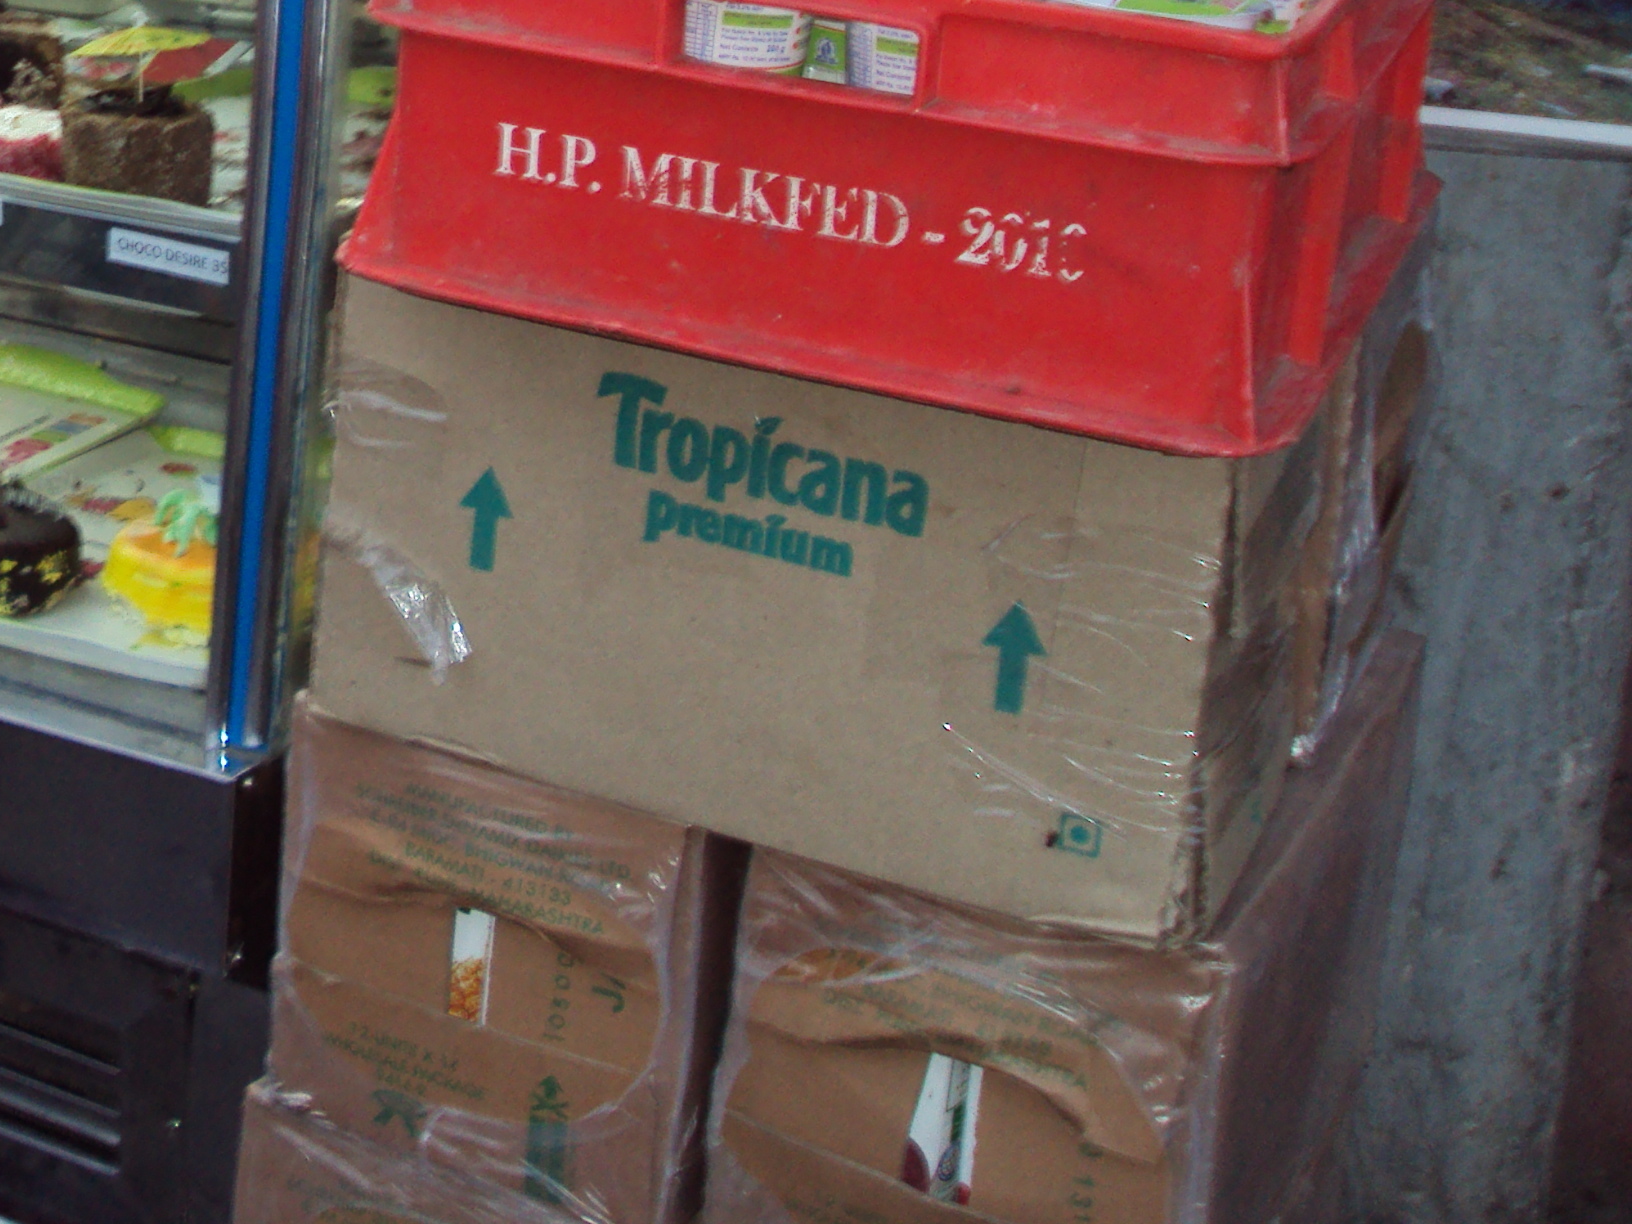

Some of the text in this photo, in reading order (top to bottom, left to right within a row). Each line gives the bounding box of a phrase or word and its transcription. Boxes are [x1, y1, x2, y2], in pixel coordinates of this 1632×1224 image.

[495, 121, 602, 194] H.P.
[619, 144, 911, 249] MILKFED
[117, 237, 228, 274] CHOCO DESIRE 35
[597, 371, 931, 538] Tropicana
[642, 487, 855, 578] premium
[404, 839, 486, 880] BARAMATI
[502, 877, 573, 907] 413133
